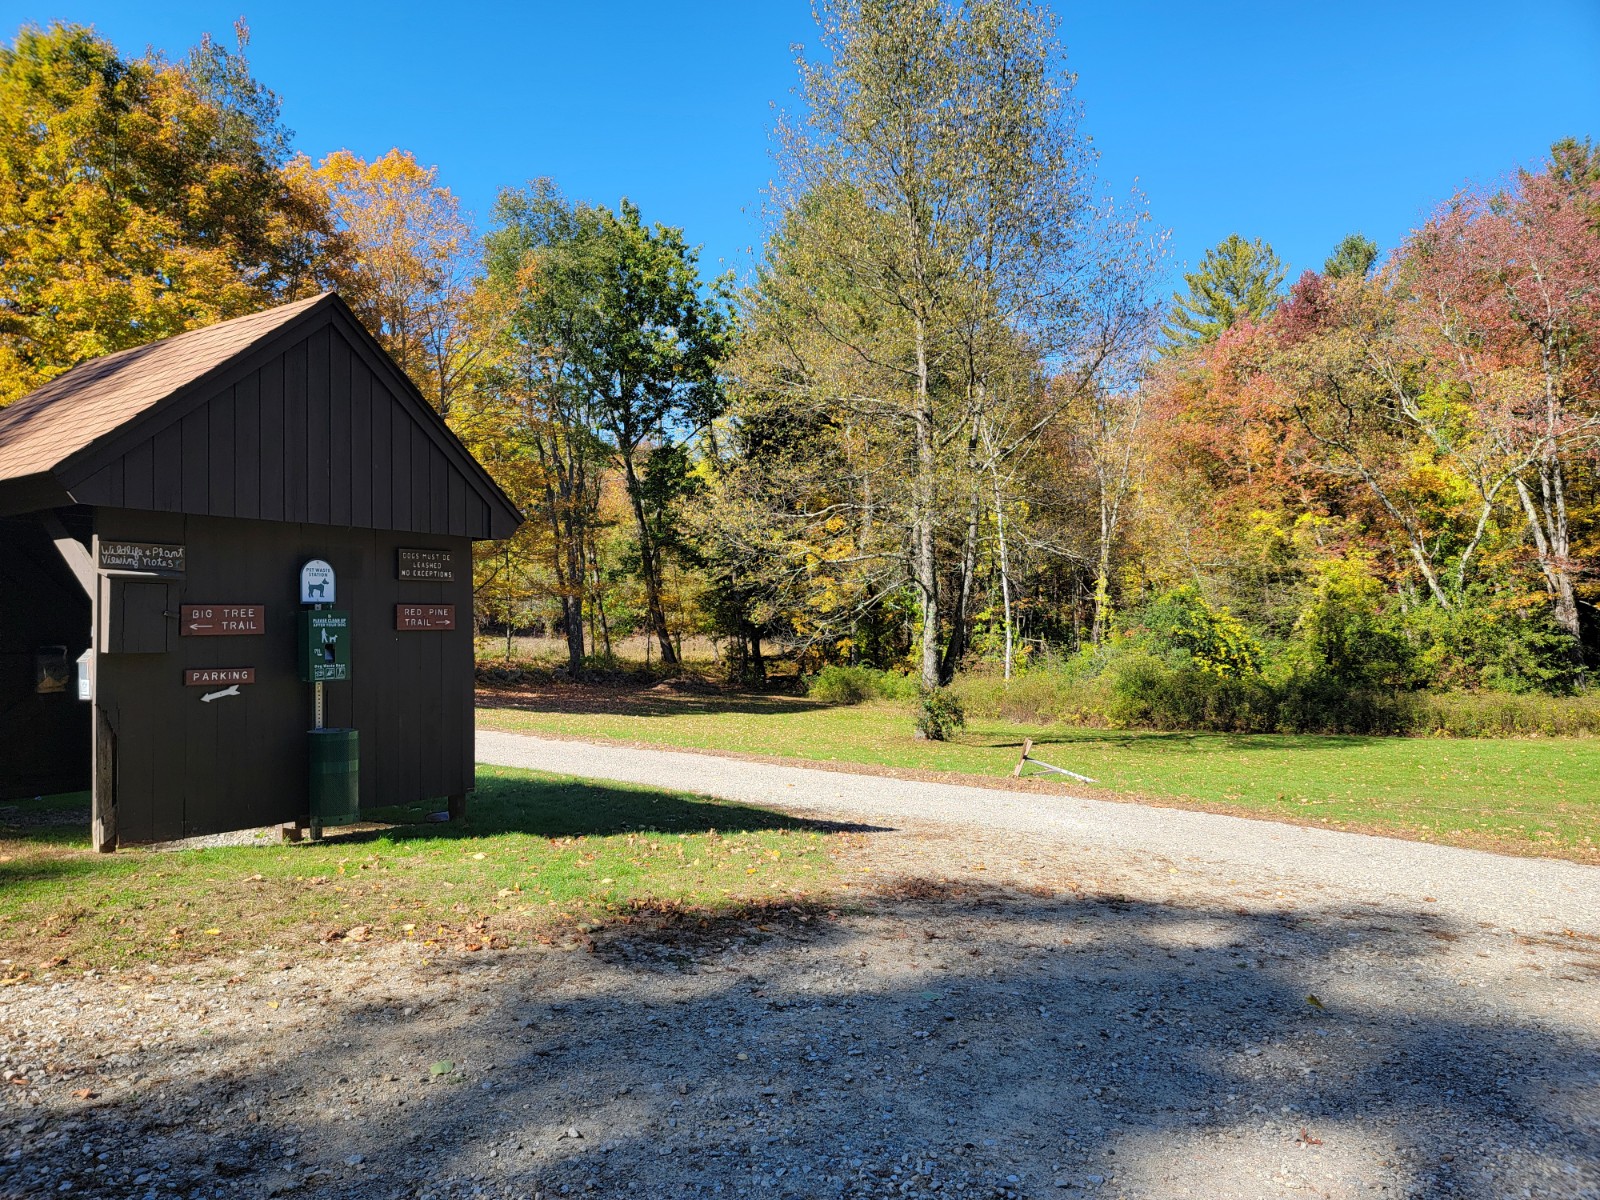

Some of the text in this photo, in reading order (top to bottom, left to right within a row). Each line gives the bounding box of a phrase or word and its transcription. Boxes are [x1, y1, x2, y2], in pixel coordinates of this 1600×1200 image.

[101, 545, 143, 559] Wildlife
[153, 547, 184, 558] Plant
[102, 555, 139, 568] Viewing
[413, 570, 452, 578] EXCEPTIONS
[192, 608, 255, 619] BIG TREE
[222, 620, 256, 630] TRAIL
[404, 618, 432, 626] TRAIL
[193, 670, 248, 681] PARKING
